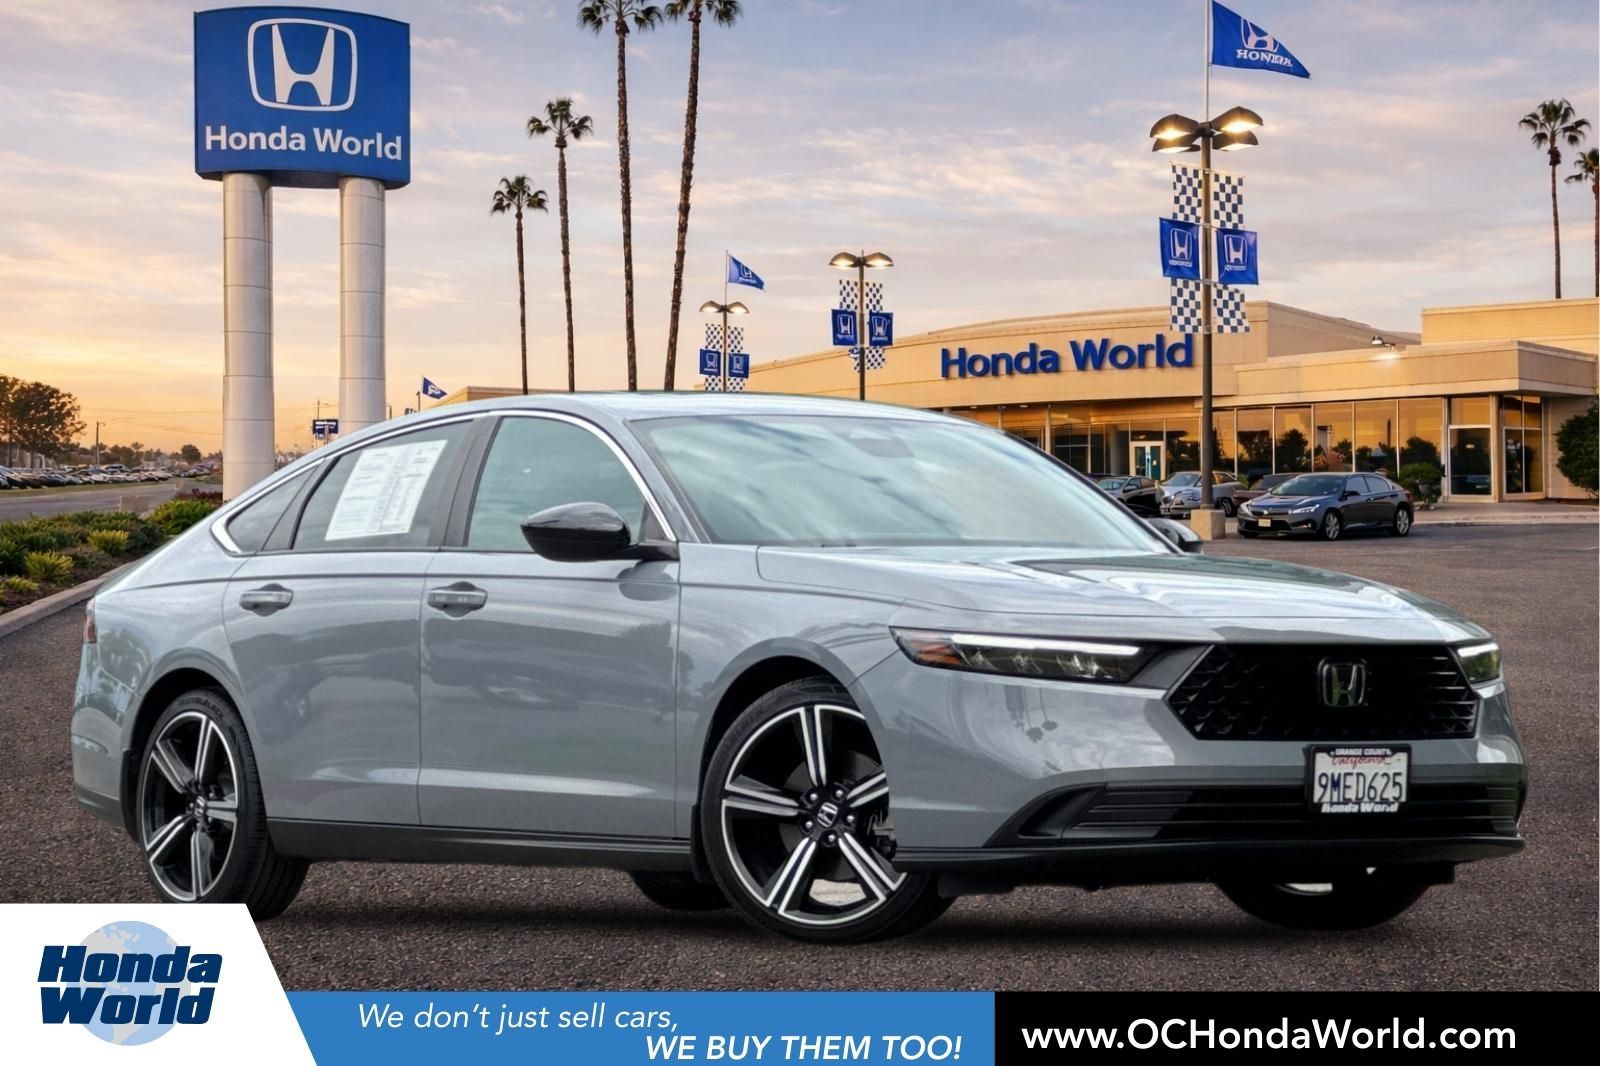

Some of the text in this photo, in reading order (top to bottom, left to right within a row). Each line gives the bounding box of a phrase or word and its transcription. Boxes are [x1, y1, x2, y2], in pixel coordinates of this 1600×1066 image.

[205, 125, 402, 161] Honda World
[941, 333, 1194, 378] Honda World
[1318, 772, 1402, 802] 9MED625
[1360, 802, 1399, 813] World
